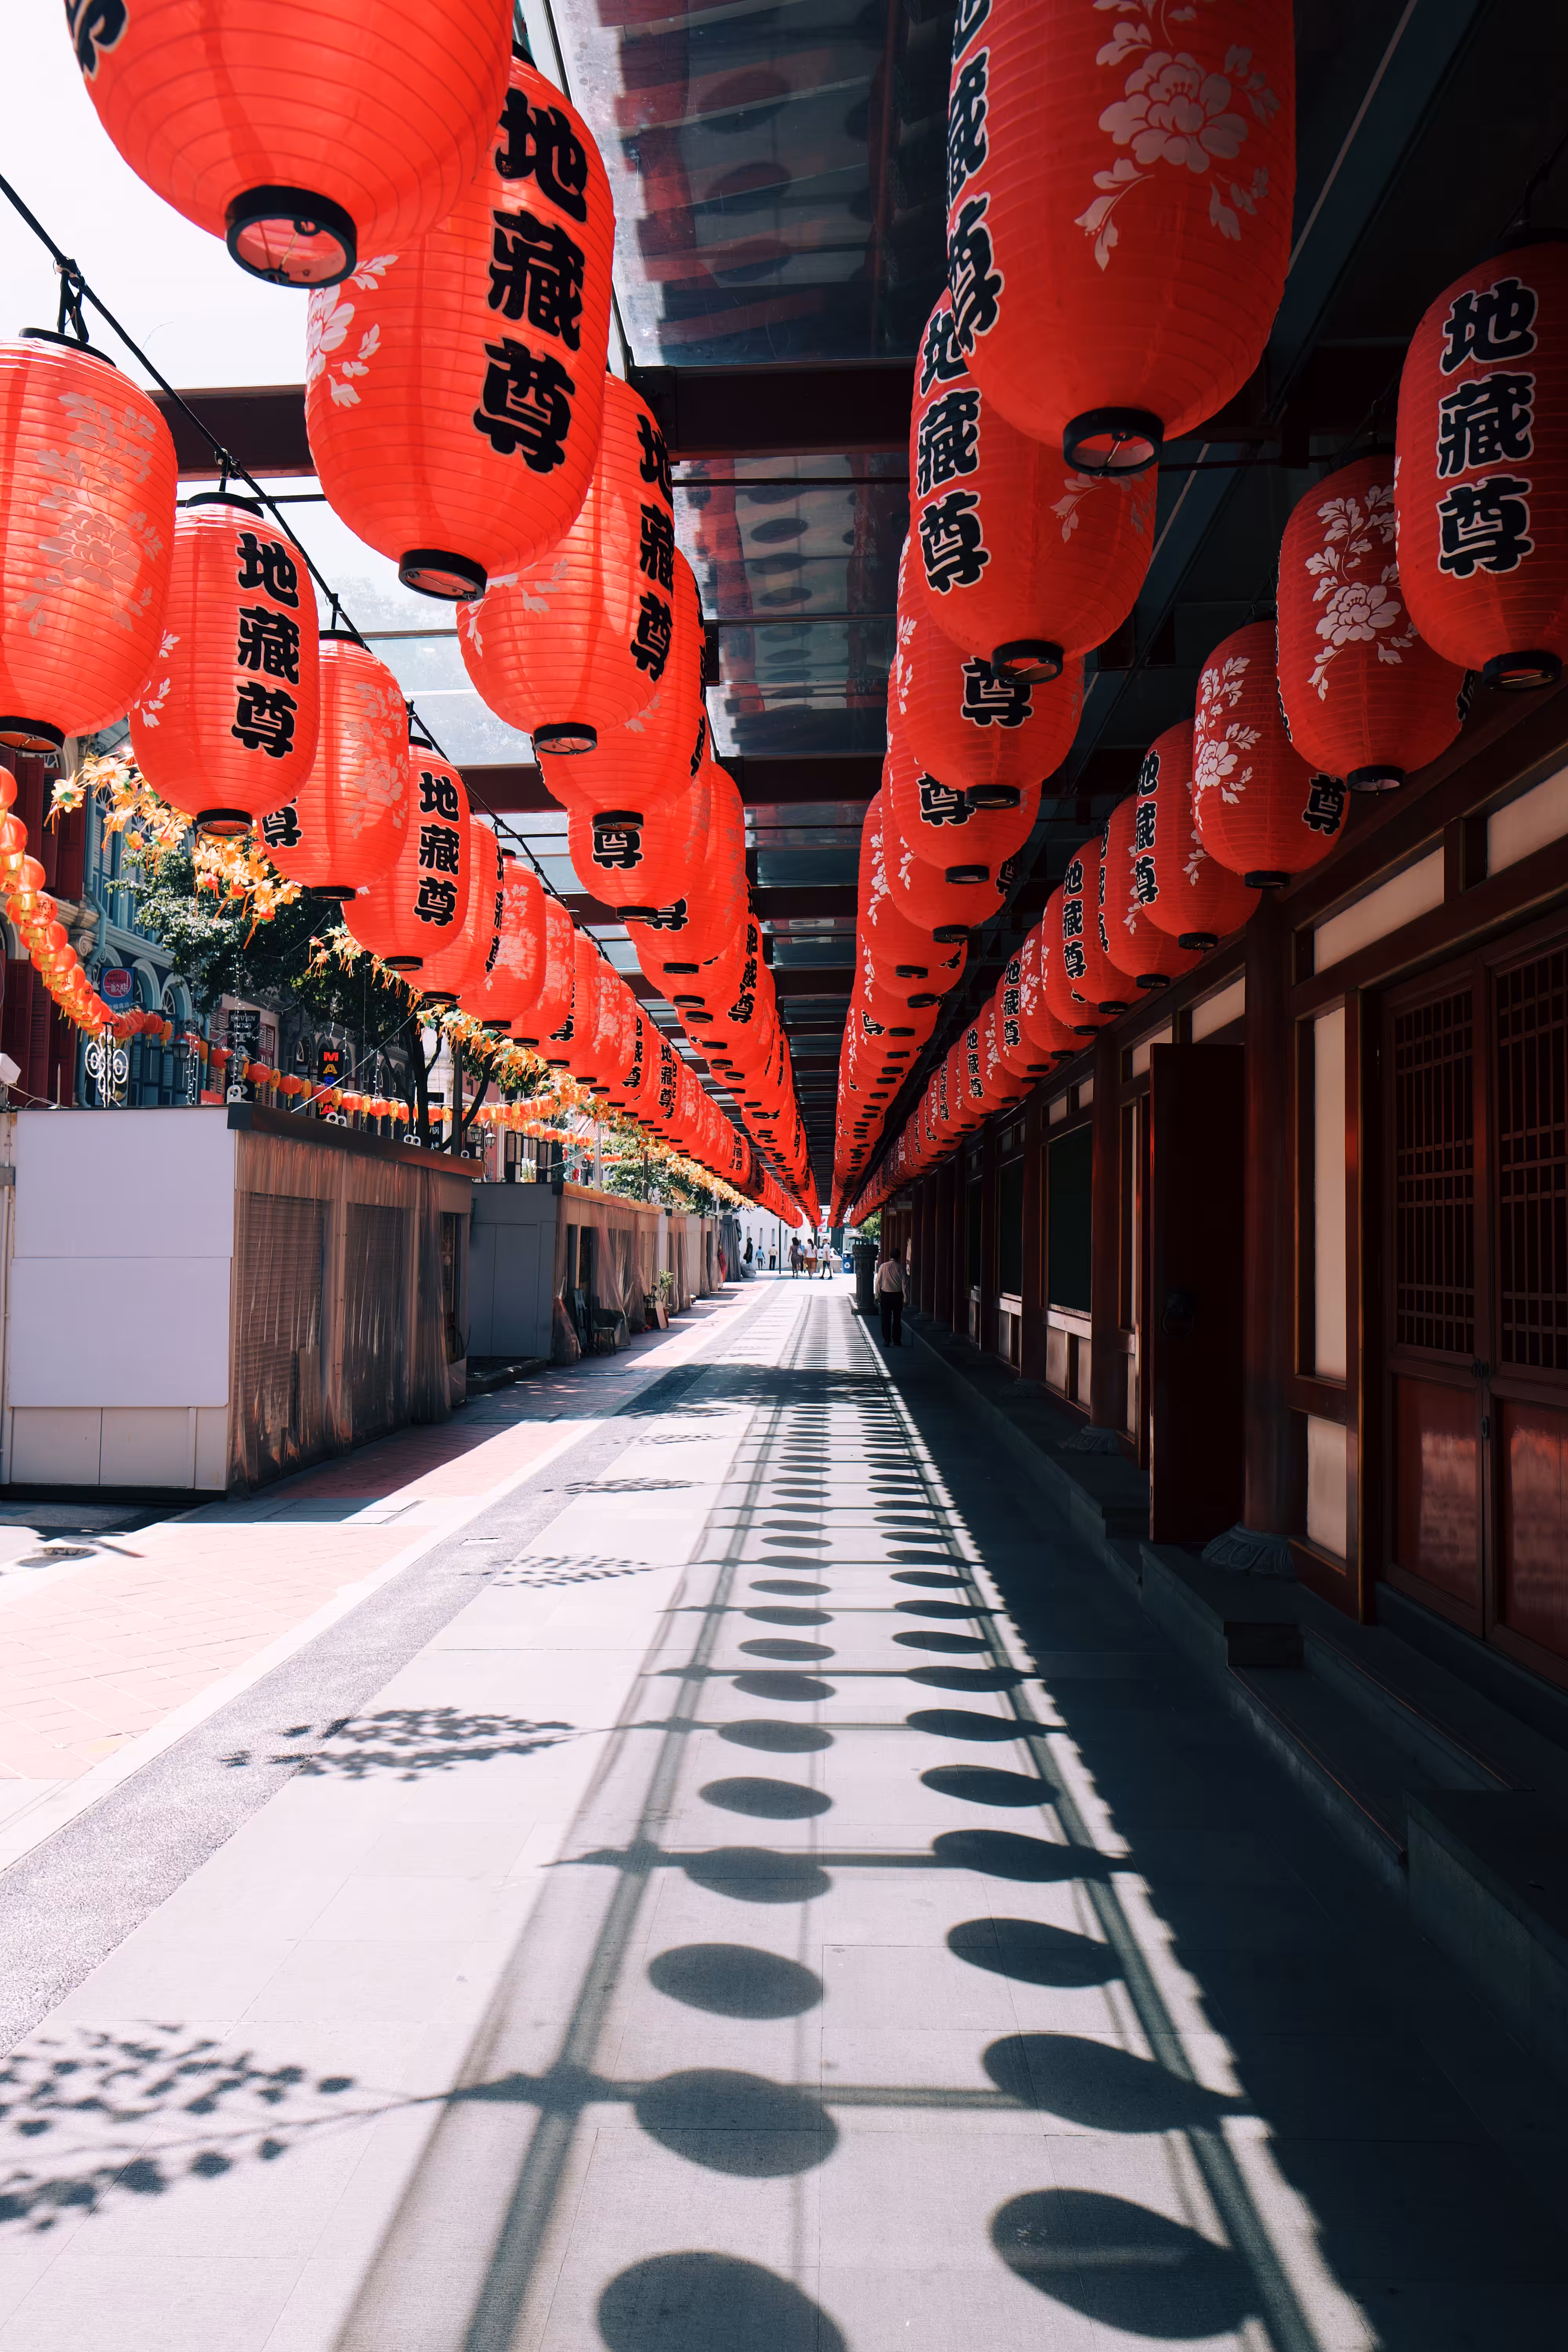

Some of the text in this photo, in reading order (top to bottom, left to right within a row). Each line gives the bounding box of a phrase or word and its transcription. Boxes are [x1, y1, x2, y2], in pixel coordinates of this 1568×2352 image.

[473, 87, 588, 474] 地藏尊
[917, 308, 991, 595] 地藏尊
[1437, 277, 1538, 579] 地藏尊
[232, 532, 301, 759] 地藏尊
[414, 771, 460, 927] 地藏尊
[1063, 858, 1087, 979] 地藏尊
[967, 1028, 984, 1098] 地藏尊
[1004, 958, 1021, 1046] 地藏尊
[320, 1052, 339, 1122] MASA
[658, 1044, 672, 1108] 地藏尊
